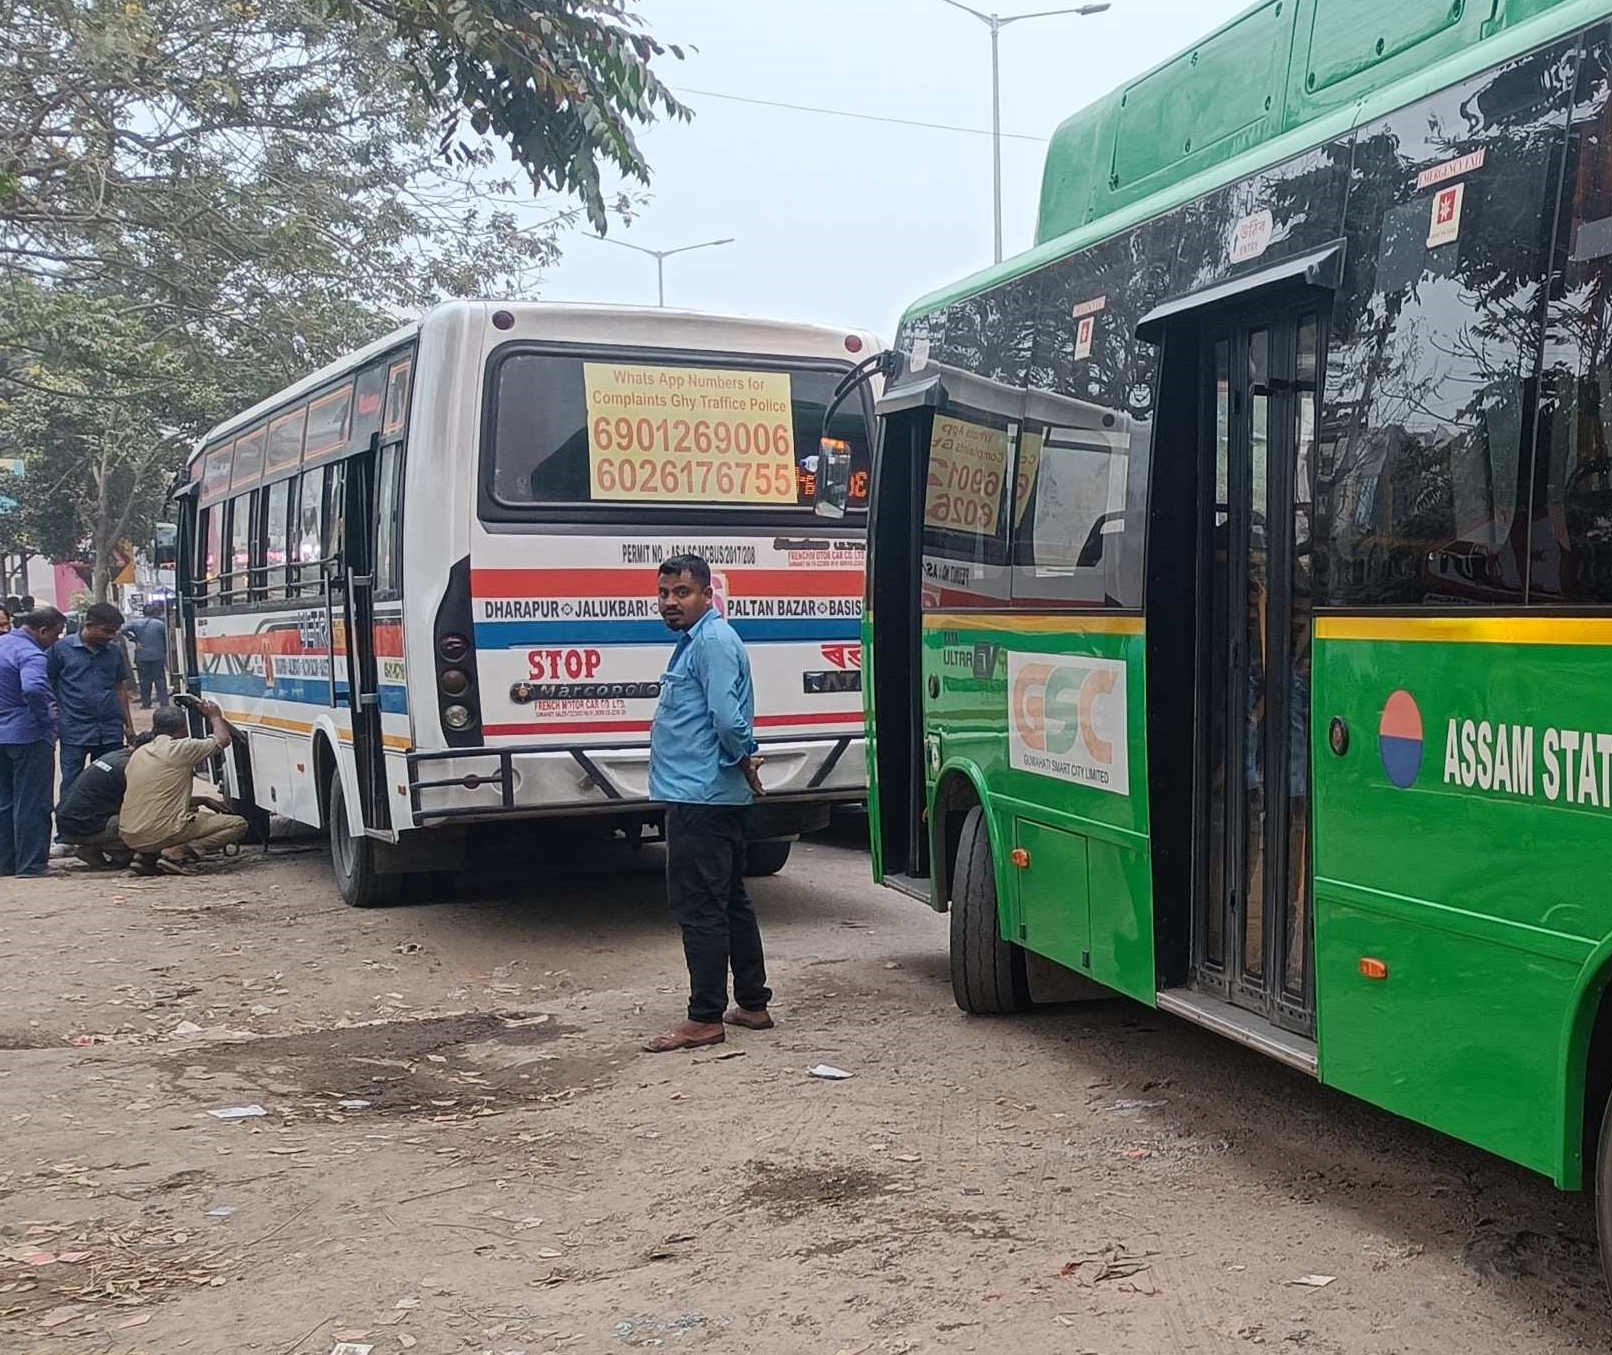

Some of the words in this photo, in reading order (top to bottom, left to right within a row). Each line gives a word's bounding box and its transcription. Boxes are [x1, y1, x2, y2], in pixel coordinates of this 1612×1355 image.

[613, 370, 654, 385] Whats
[659, 372, 685, 389] App
[688, 373, 744, 390] Numbers
[748, 376, 765, 390] for
[593, 390, 667, 408] Complaints
[671, 393, 696, 411] Ghy
[700, 395, 746, 411] Traffice
[750, 398, 786, 412] Police
[593, 416, 790, 456] 6901269006
[596, 458, 791, 496] 6026176755
[622, 544, 650, 563] PERMIT
[485, 599, 559, 619] DHARAPUR
[575, 599, 649, 618] JALUKBARI
[727, 599, 774, 617] PALTAN
[777, 599, 815, 617] BAZAR
[528, 649, 601, 681] STOP
[943, 650, 973, 668] ULTRA
[535, 700, 560, 711] FRENCH
[585, 699, 600, 709] CAR
[1442, 719, 1534, 794] ASSAM
[1051, 759, 1070, 775] SMART
[1071, 764, 1085, 779] CITY
[1085, 768, 1109, 784] LIMITED
